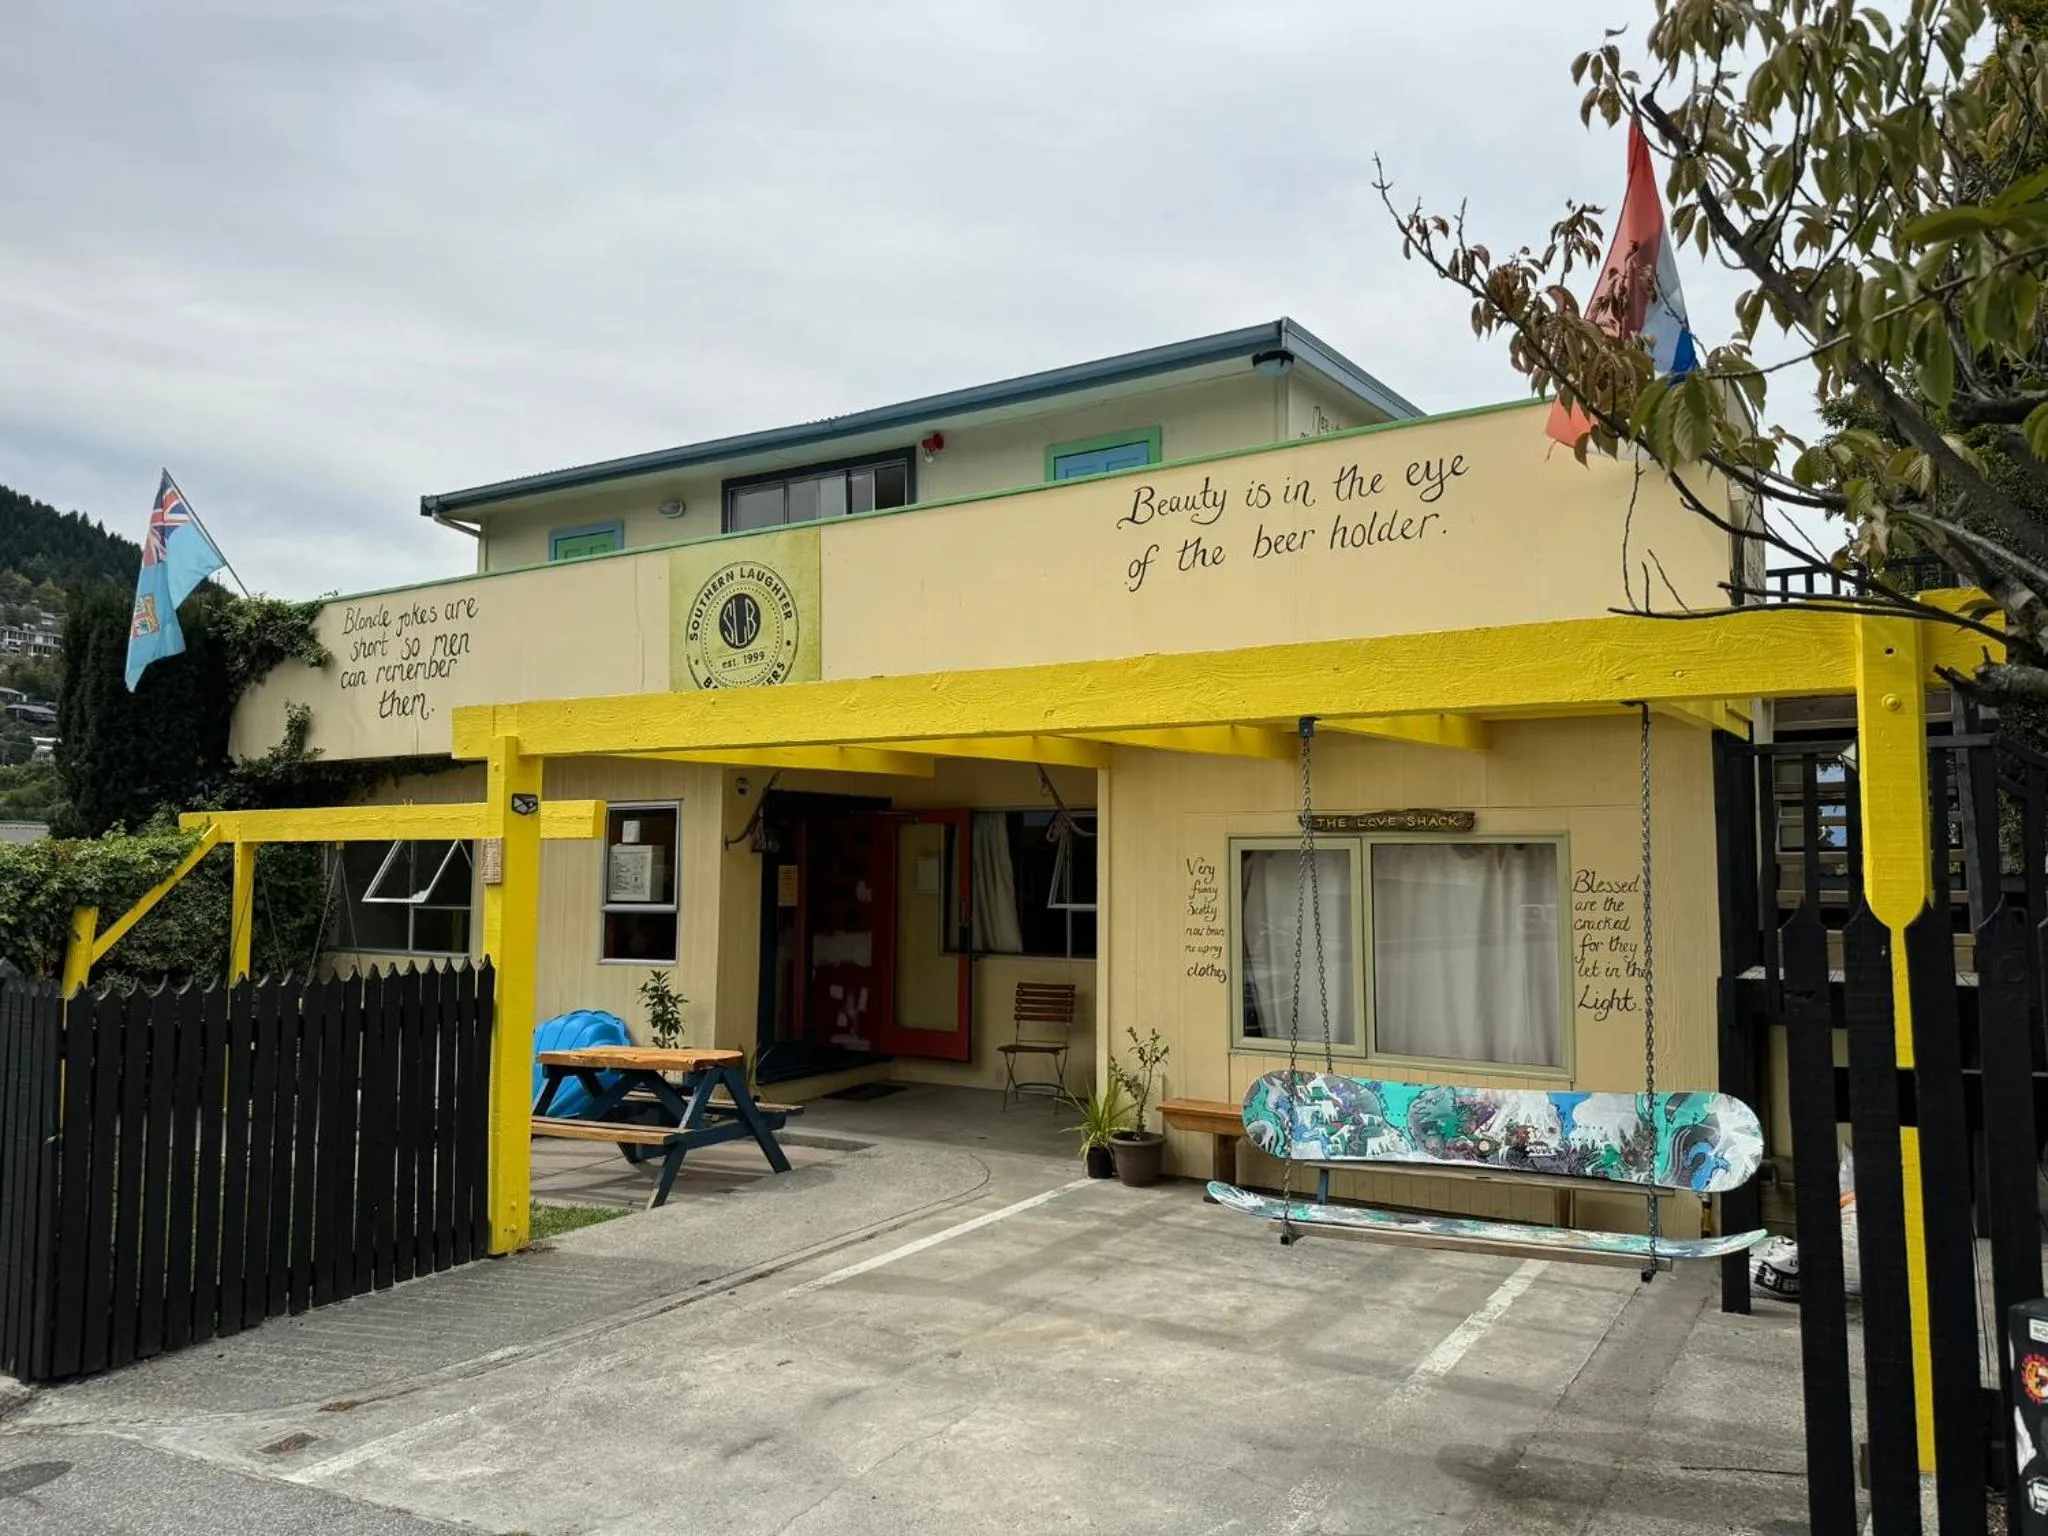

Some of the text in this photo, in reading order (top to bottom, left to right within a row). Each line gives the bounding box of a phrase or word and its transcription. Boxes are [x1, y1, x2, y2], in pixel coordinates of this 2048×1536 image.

[1117, 452, 1469, 529] Beauty is in the eye
[1128, 510, 1448, 592] of the beer holder.
[342, 596, 479, 637] Blonde jokes are
[689, 567, 793, 641] SOUTHERN LAUGHTER
[350, 632, 470, 662] short so men
[721, 651, 765, 669] est. 1999
[340, 656, 458, 689] can remember
[379, 688, 435, 721] them.
[1316, 815, 1460, 829] THE LOVE SHACK
[1186, 856, 1216, 884] Very
[1573, 869, 1640, 893] Blessed
[1575, 897, 1624, 912] are the
[1574, 916, 1631, 931] cracked
[1575, 932, 1638, 963] for they
[1578, 957, 1646, 979] let in the
